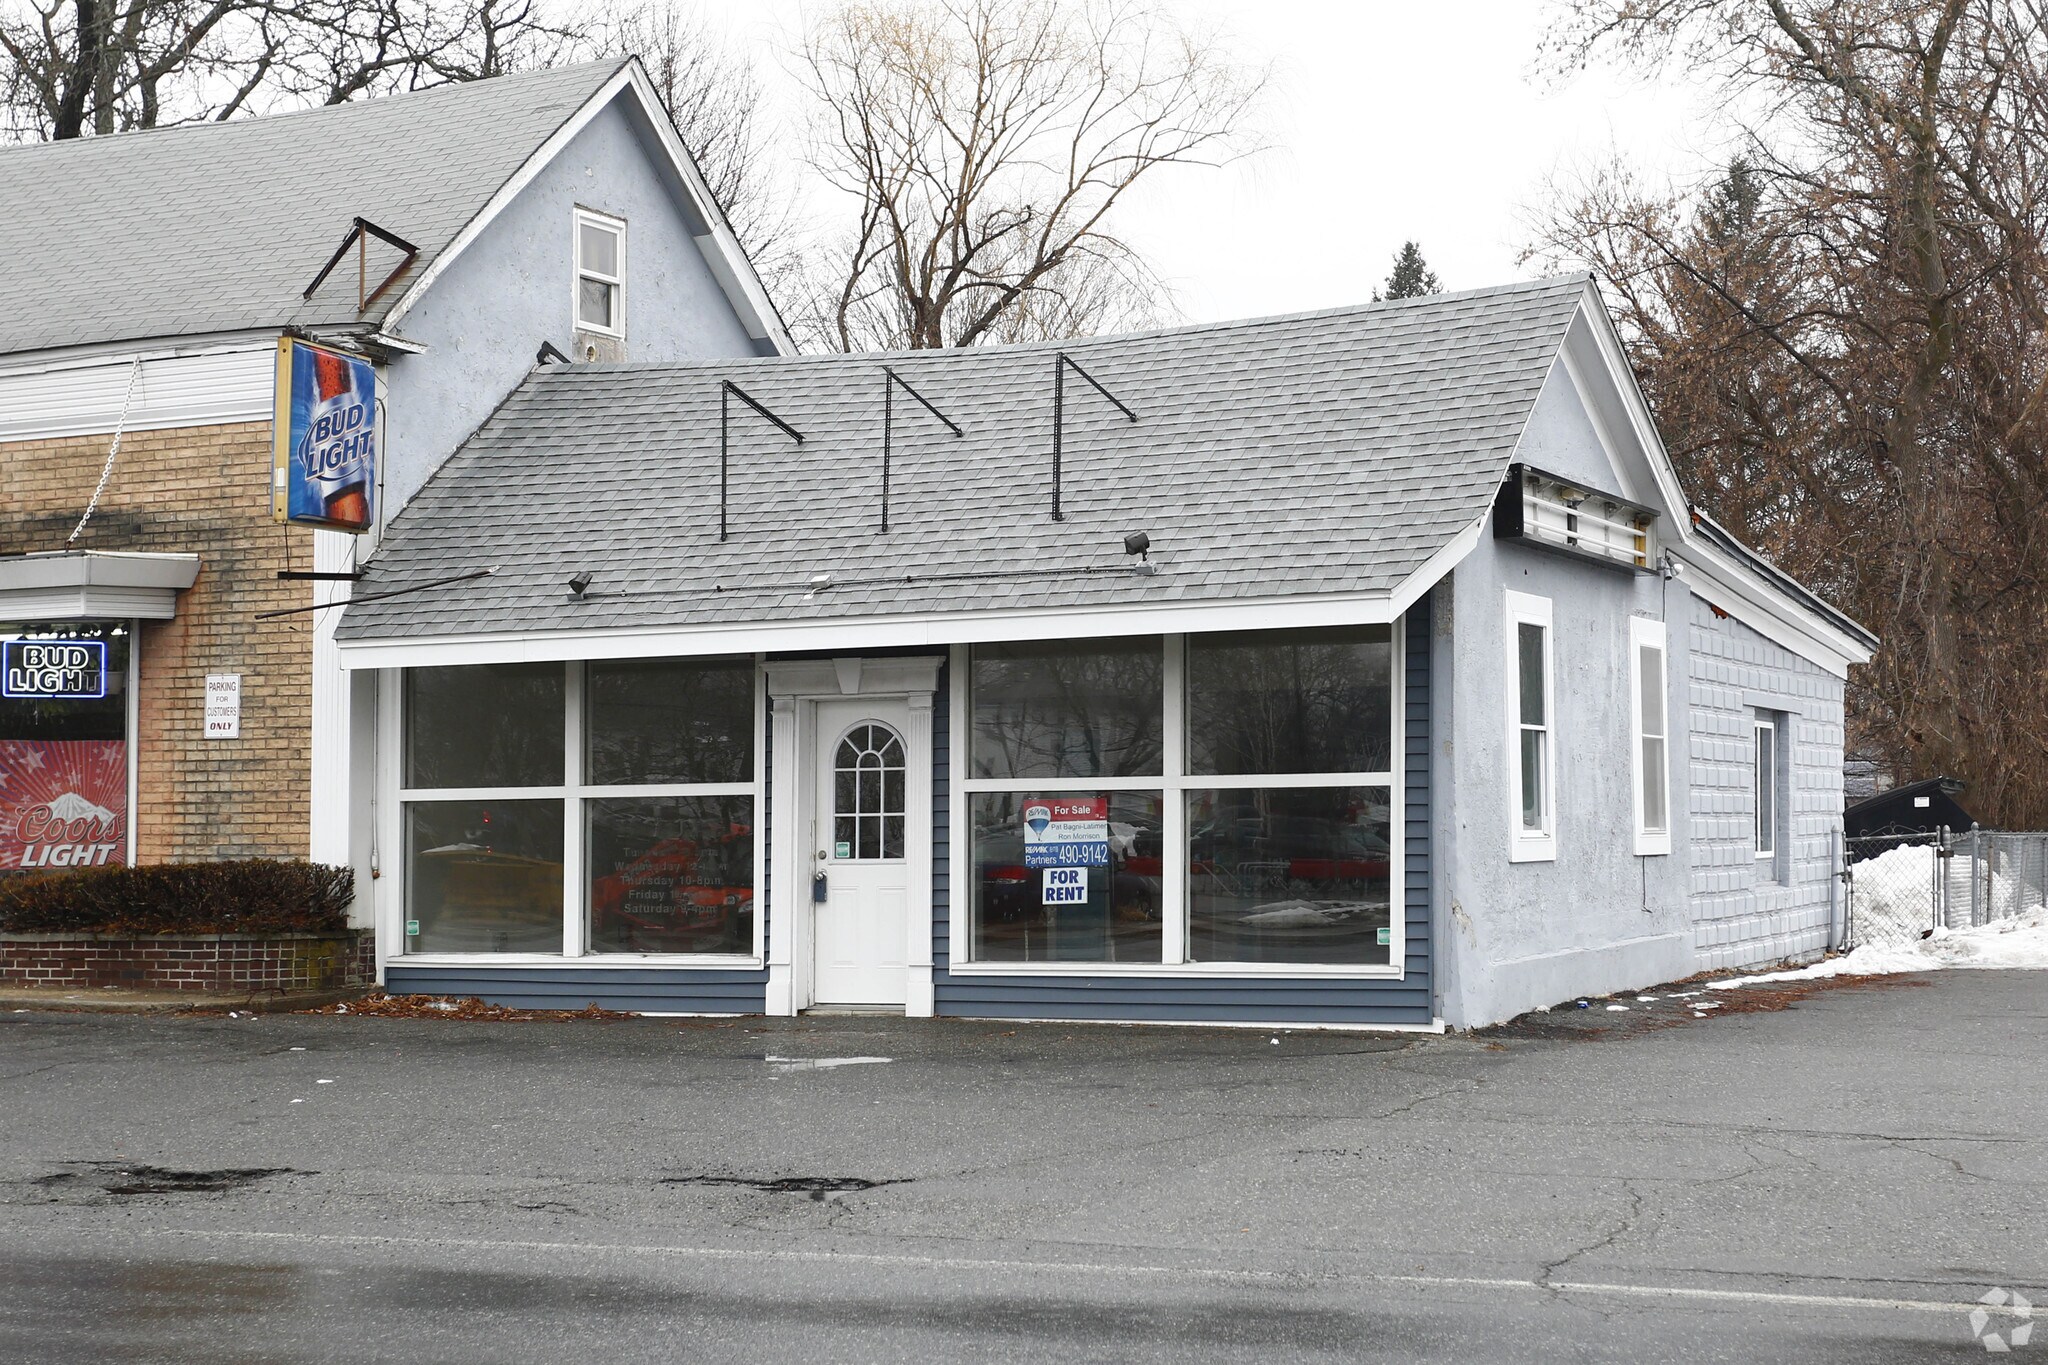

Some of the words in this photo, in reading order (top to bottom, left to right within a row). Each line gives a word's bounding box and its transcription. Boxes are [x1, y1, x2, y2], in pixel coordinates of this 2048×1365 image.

[315, 404, 364, 445] BUD
[305, 429, 373, 481] LIGHT
[23, 645, 89, 669] BUD
[9, 668, 100, 692] LIGHT
[208, 681, 237, 692] PARKING
[215, 695, 229, 703] FOR
[207, 706, 237, 717] CUSTOMERS
[210, 722, 233, 731] ONLY
[1054, 806, 1070, 815] For
[1071, 805, 1091, 815] Sale
[15, 804, 124, 844] Coors
[20, 844, 117, 867] LIGHT
[1025, 855, 1057, 865] Partners
[1059, 844, 1108, 863] 490-9142
[614, 861, 681, 872] Wdneday
[620, 875, 674, 887] Thursday
[680, 875, 721, 887] 10-8pm
[1050, 870, 1079, 885] FOR
[628, 890, 665, 902] Friday
[1045, 886, 1085, 902] RENT
[623, 903, 676, 916] Saturday
